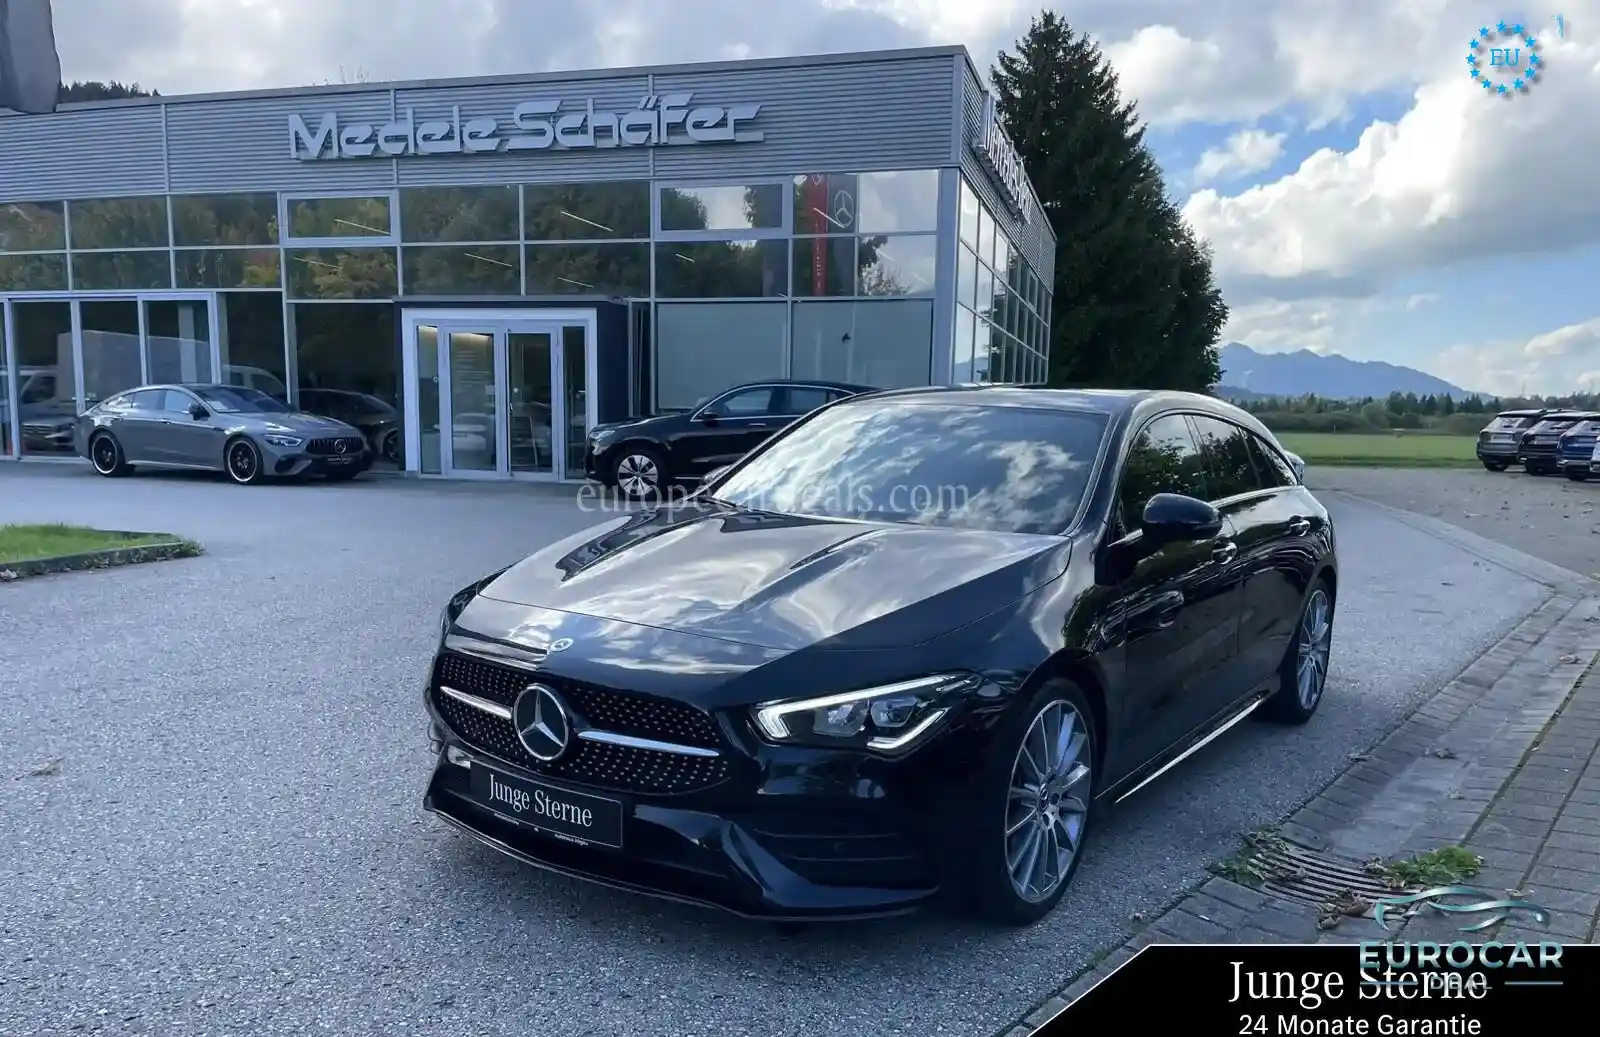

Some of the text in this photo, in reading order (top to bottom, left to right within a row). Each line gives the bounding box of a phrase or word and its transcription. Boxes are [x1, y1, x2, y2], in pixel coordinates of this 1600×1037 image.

[288, 92, 765, 160] Medele Schäfer
[489, 774, 593, 827] Junge Sterne
